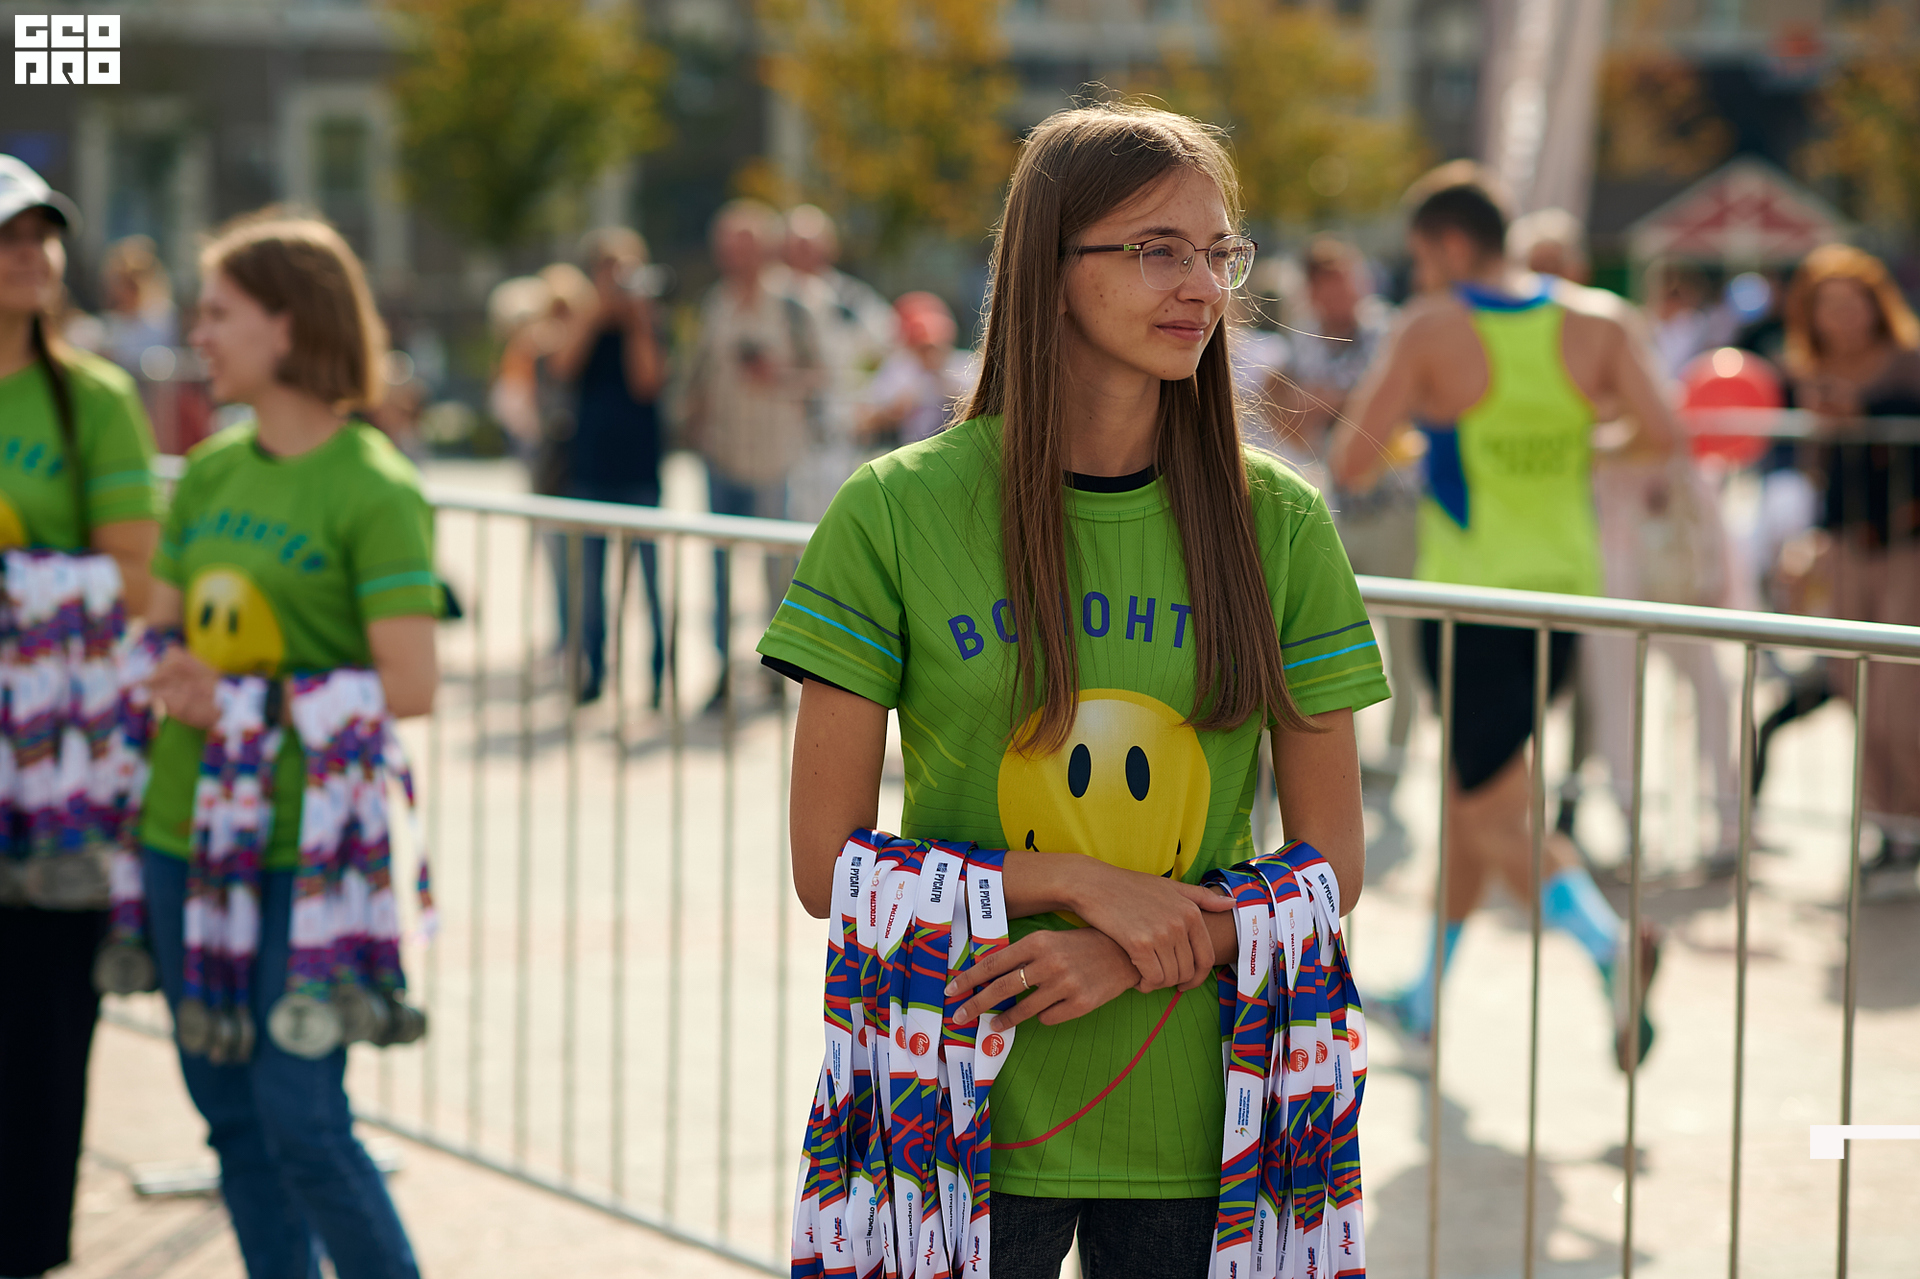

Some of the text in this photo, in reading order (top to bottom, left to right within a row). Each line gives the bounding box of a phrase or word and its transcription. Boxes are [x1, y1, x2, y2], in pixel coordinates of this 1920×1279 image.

[948, 591, 1192, 661] ВООНТ
[930, 874, 945, 903] РУСАГРО
[979, 890, 993, 920] РУСАГРО
[884, 903, 898, 939] РОСГОССТРАХ
